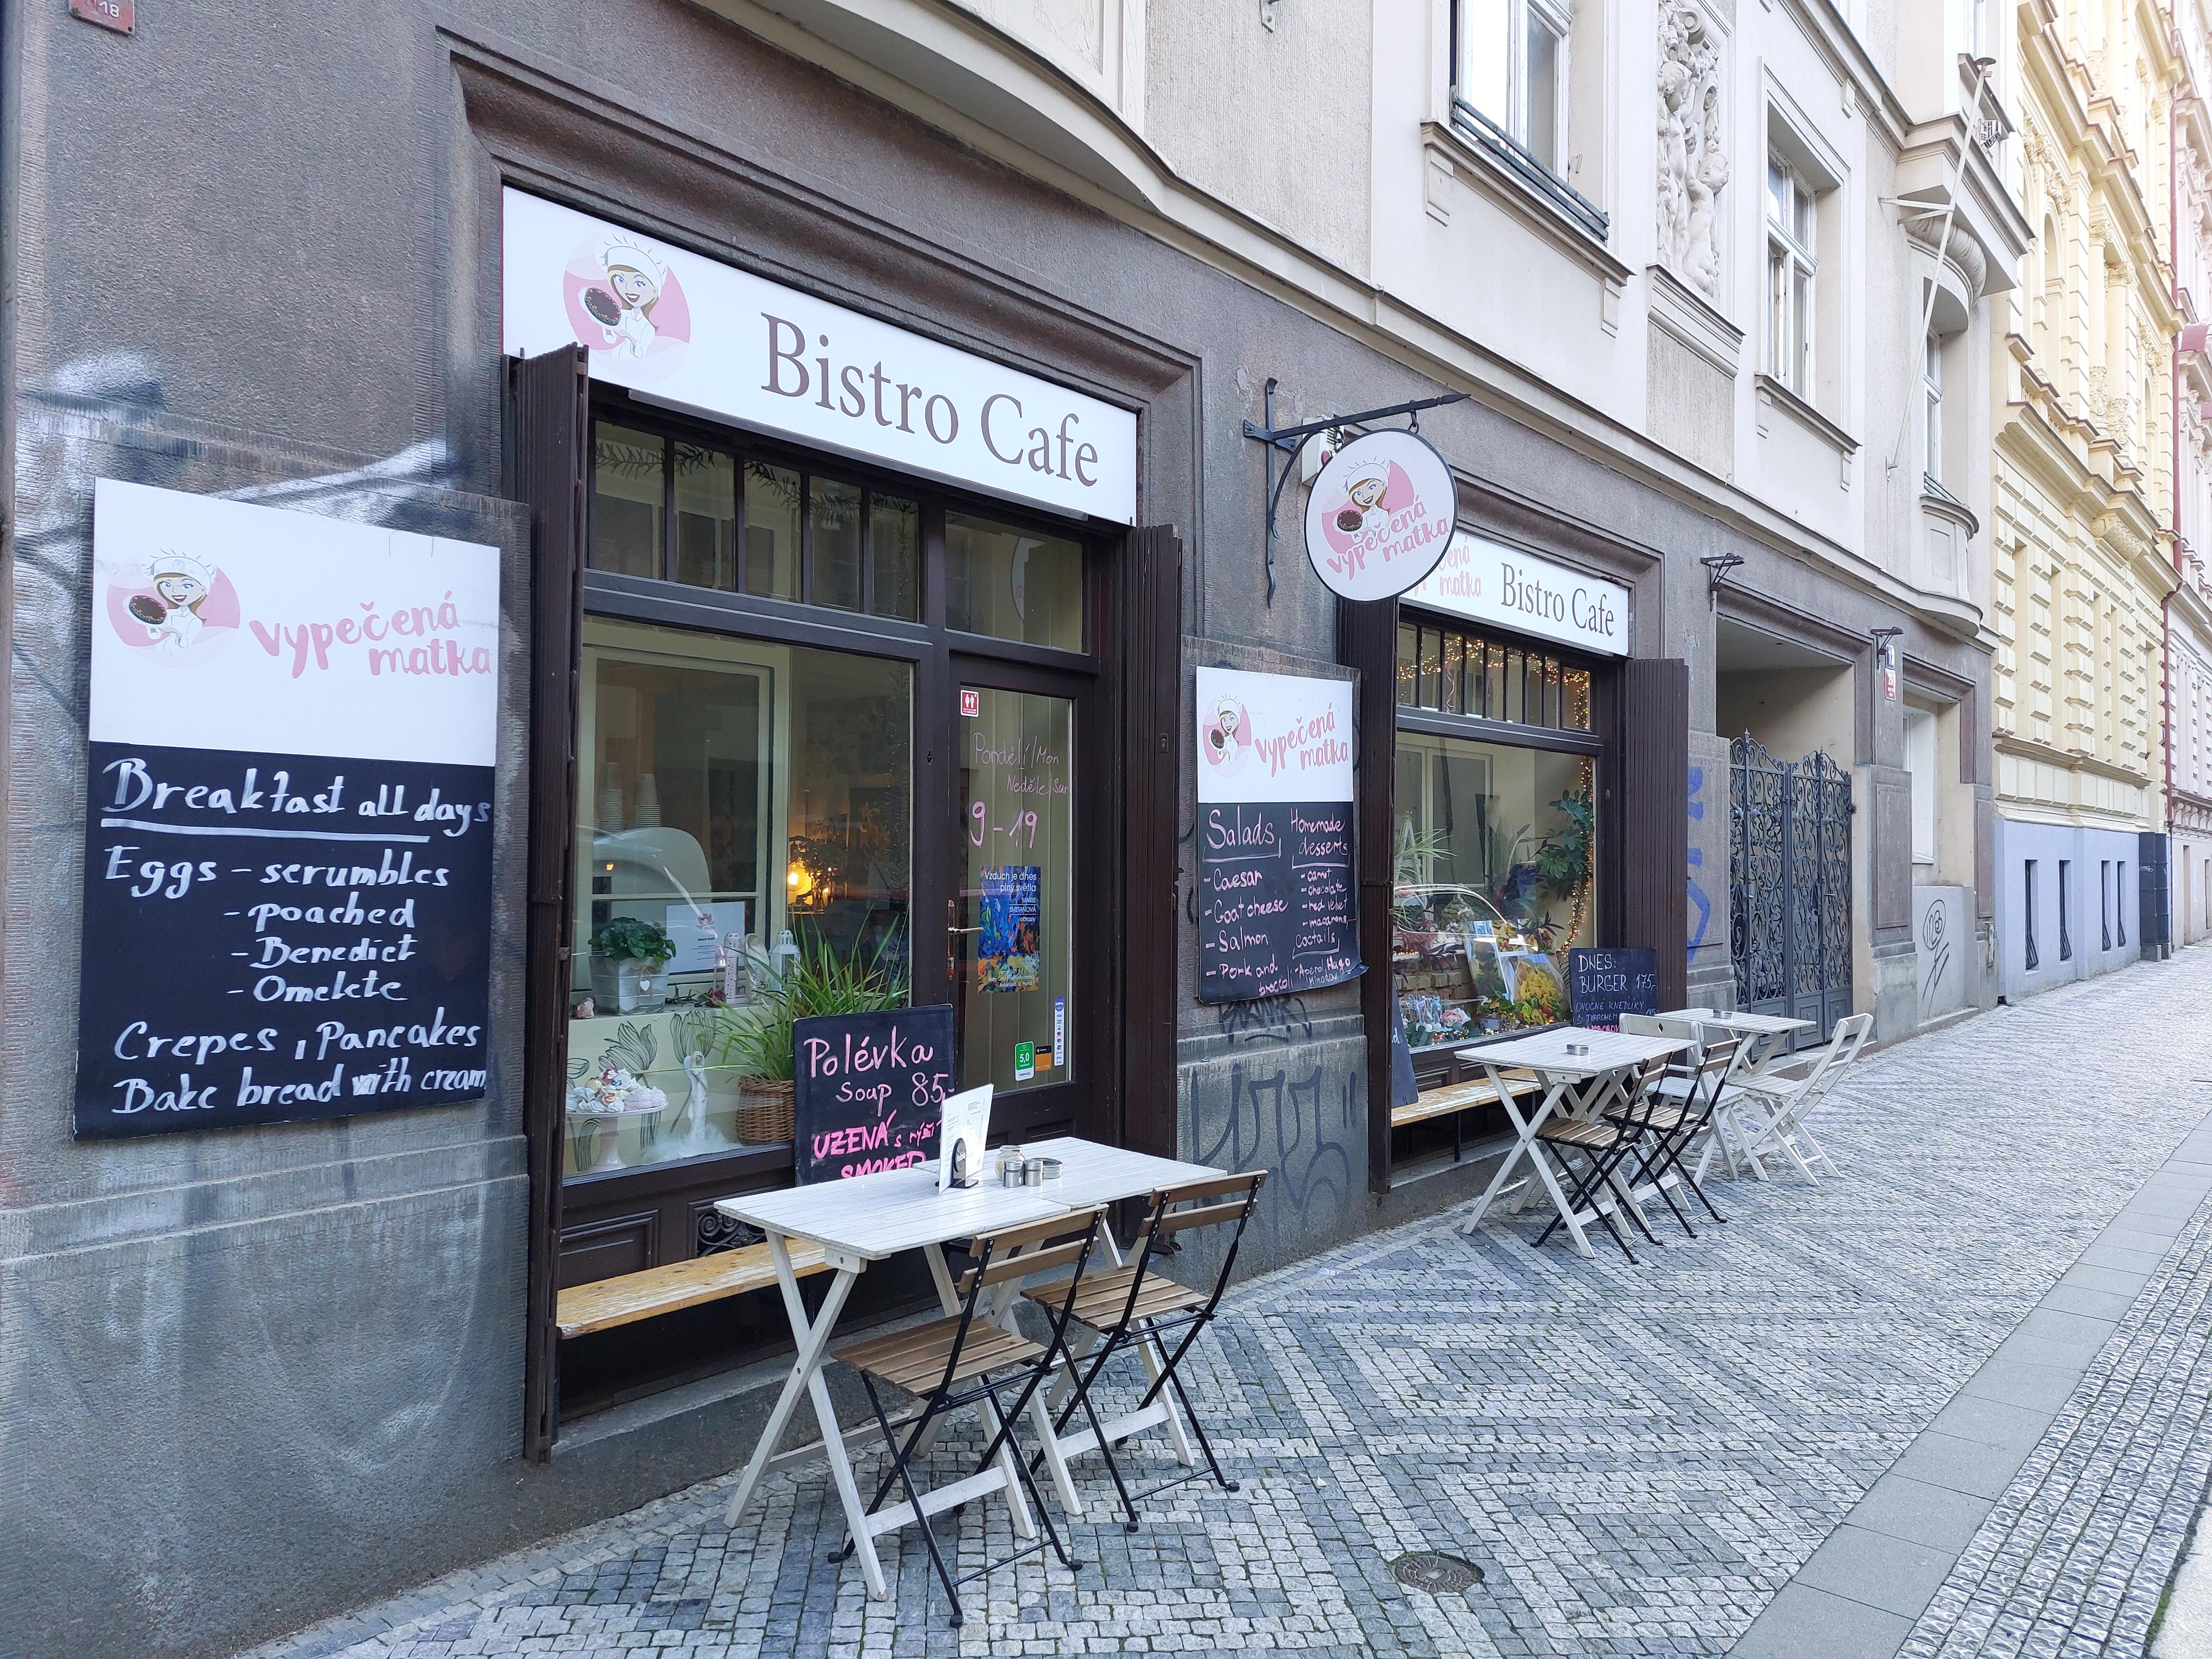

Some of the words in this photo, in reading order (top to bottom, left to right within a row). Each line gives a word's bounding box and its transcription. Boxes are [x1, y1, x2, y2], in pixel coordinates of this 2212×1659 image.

[98, 1, 119, 18] 18
[761, 312, 959, 444] Bistro
[980, 393, 1098, 487] Cafe
[1326, 495, 1428, 581] vypečená
[1383, 518, 1449, 562] matka
[1439, 571, 1481, 597] matka
[1500, 562, 1565, 623] Bistro
[1572, 587, 1615, 637] Cafe
[249, 590, 460, 679] vypečená
[369, 639, 492, 676] matka
[1255, 702, 1335, 778] vypečená
[1300, 739, 1348, 770] matka
[101, 758, 345, 814] Breakfast
[359, 785, 405, 816] all
[414, 789, 491, 837] days
[1206, 805, 1275, 849] Salads
[1290, 808, 1345, 833] Homemade
[1299, 836, 1348, 857] desserts
[105, 846, 217, 899] Eggs
[260, 849, 450, 886] scrumbles
[985, 871, 1010, 880] Vzduch
[1011, 872, 1018, 882] je
[1019, 872, 1037, 880] dnes
[1000, 883, 1015, 893] plný
[1016, 883, 1036, 891] světla
[1214, 868, 1262, 892] Caesar
[1308, 879, 1347, 896] chocolate
[248, 891, 415, 932] poached
[1214, 896, 1244, 924] Goat
[1247, 896, 1288, 917] cheese
[249, 934, 419, 969] Benedict
[1219, 926, 1269, 952] Salmon
[1219, 958, 1252, 979] Pork
[1256, 953, 1278, 978] and
[1578, 953, 1616, 972] DNES:
[1579, 974, 1627, 993] BURGER
[804, 1025, 933, 1078] Polévka
[1019, 1052, 1030, 1063] 5,0
[112, 1074, 218, 1114] Bake
[237, 1063, 344, 1107] bread
[352, 1057, 410, 1096] with
[813, 1109, 897, 1160] UZENÁ
